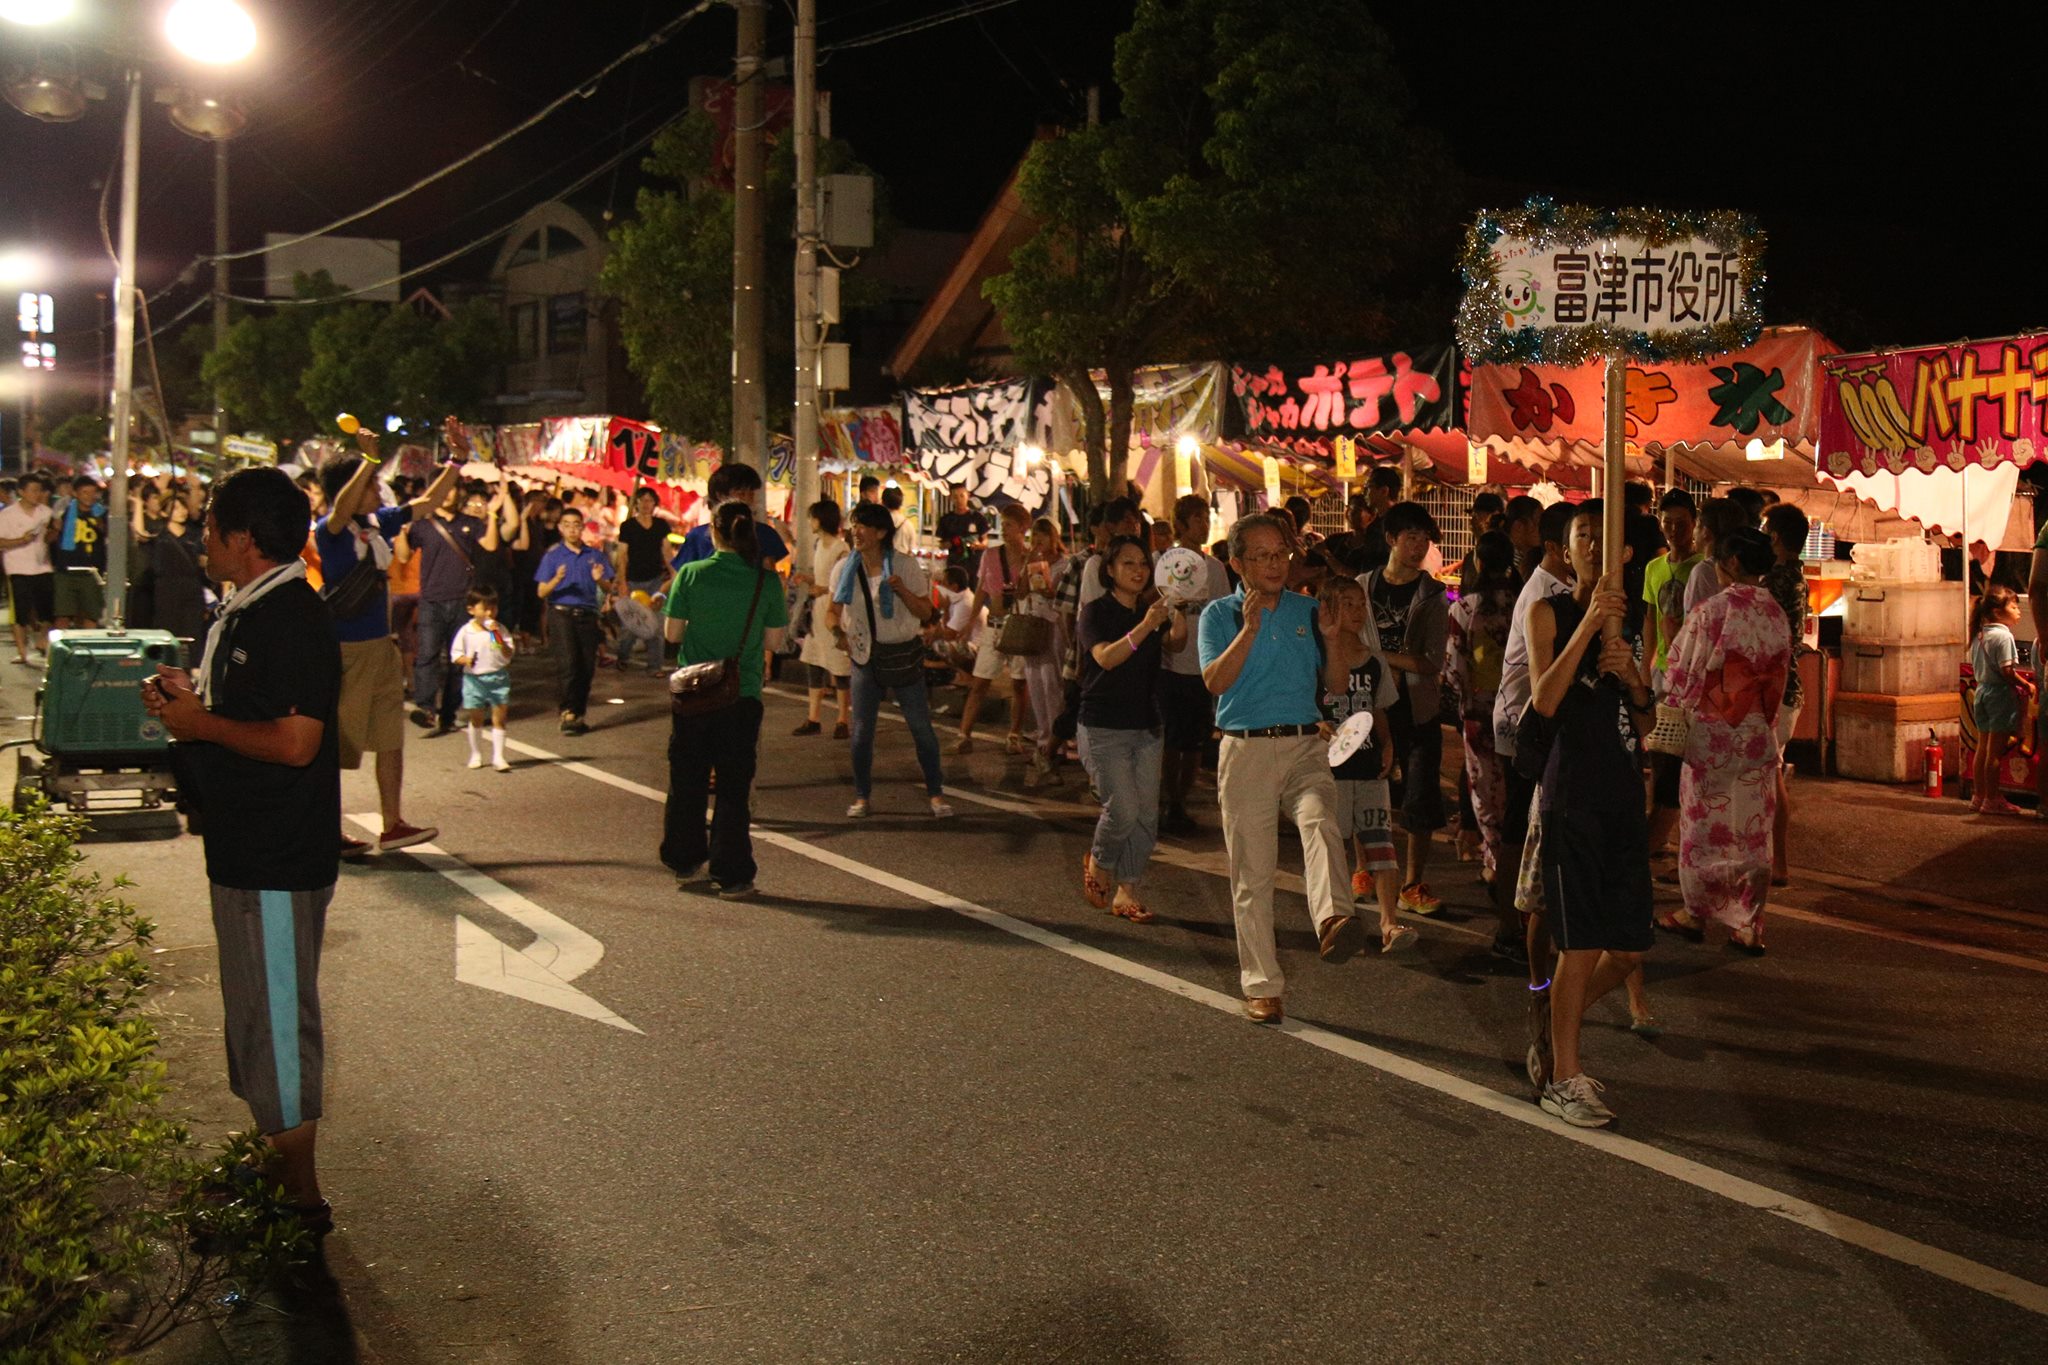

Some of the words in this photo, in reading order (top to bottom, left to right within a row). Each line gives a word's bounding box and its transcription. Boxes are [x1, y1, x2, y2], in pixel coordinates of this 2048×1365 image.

[1553, 248, 1739, 324] 富津市役所
[1298, 351, 1441, 432] ポテト
[1503, 366, 1795, 438] かき氷
